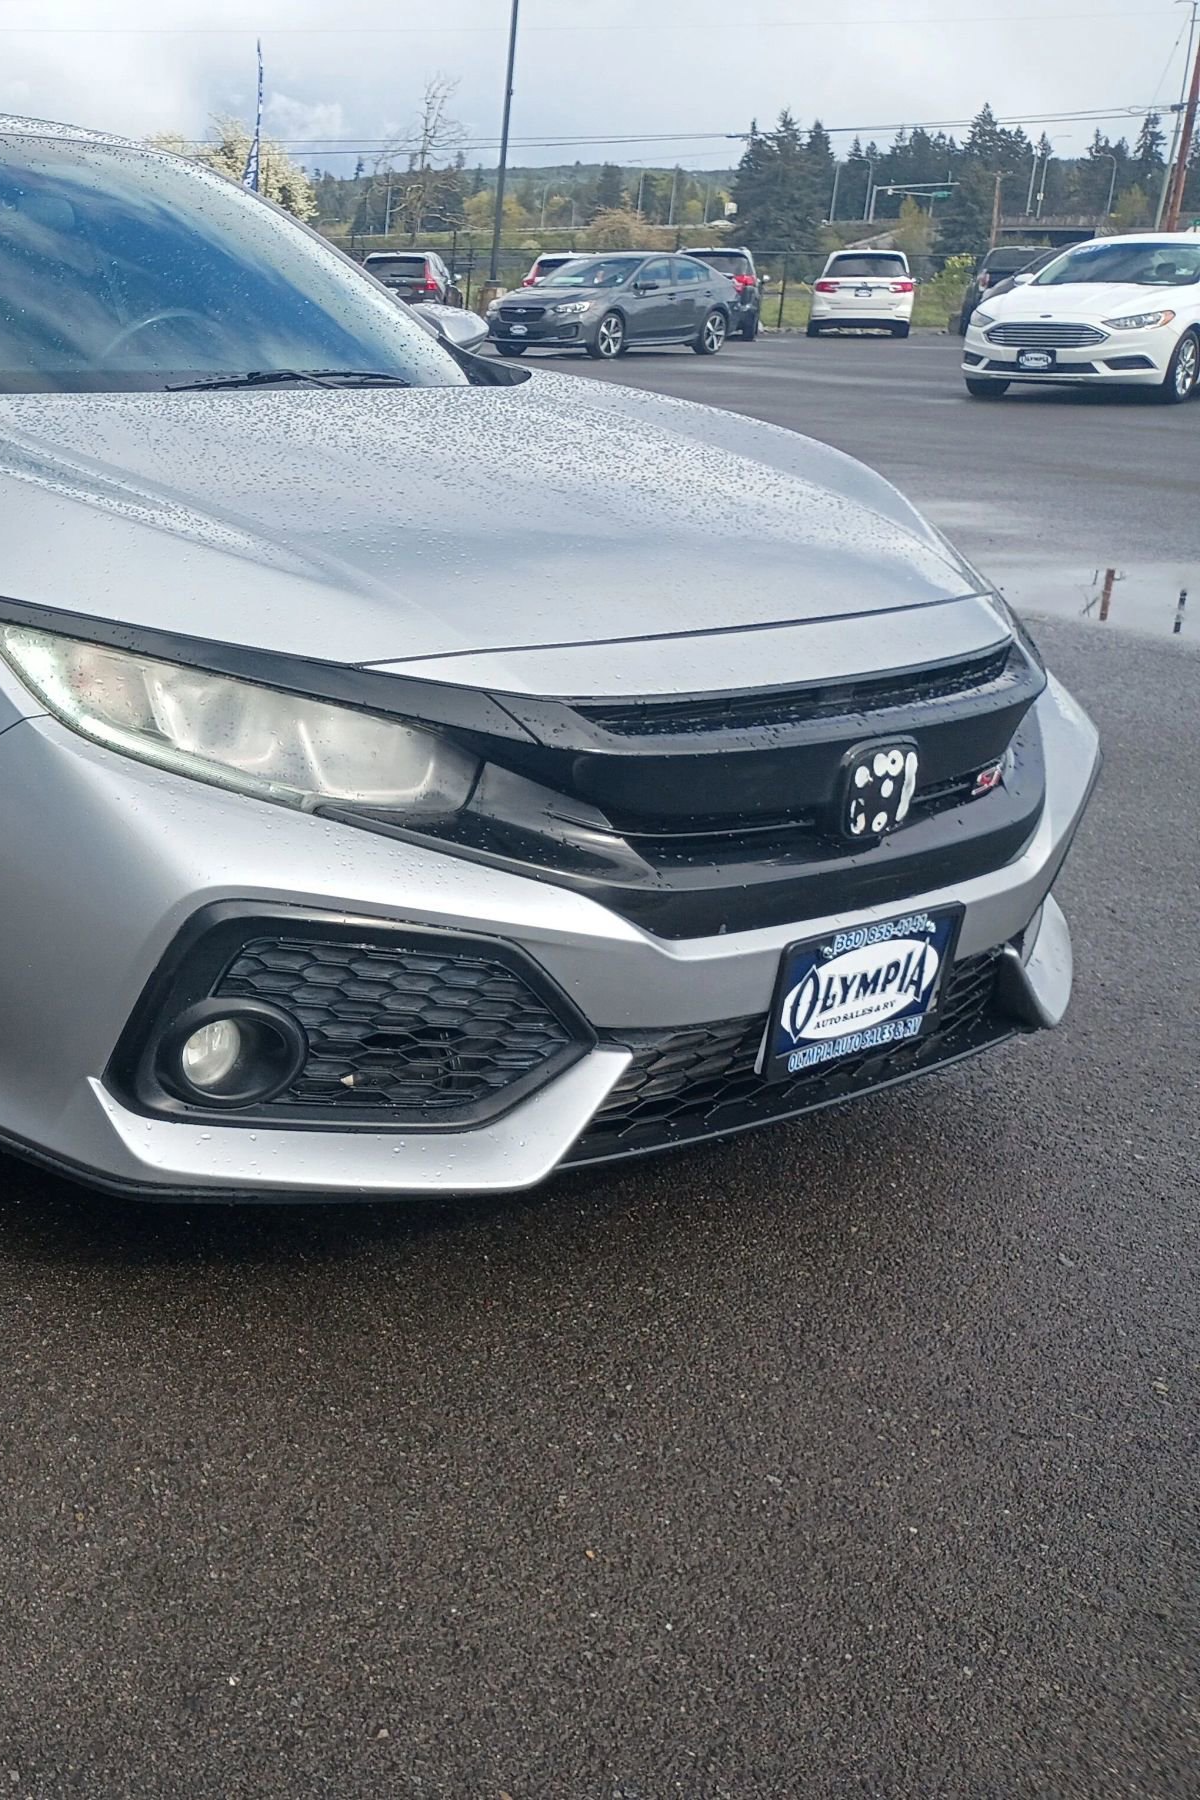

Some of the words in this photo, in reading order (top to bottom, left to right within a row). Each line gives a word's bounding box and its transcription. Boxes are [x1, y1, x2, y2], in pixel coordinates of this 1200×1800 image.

[790, 938, 929, 1043] OLYMPIA
[814, 1016, 841, 1030] AUTO
[841, 1006, 874, 1022] SALES
[882, 1000, 896, 1010] RV
[788, 1041, 834, 1073] OLYMPIA
[832, 1034, 862, 1057] AUTO
[861, 1023, 894, 1049] SALES
[893, 1021, 905, 1040] &
[904, 1016, 923, 1038] RV
